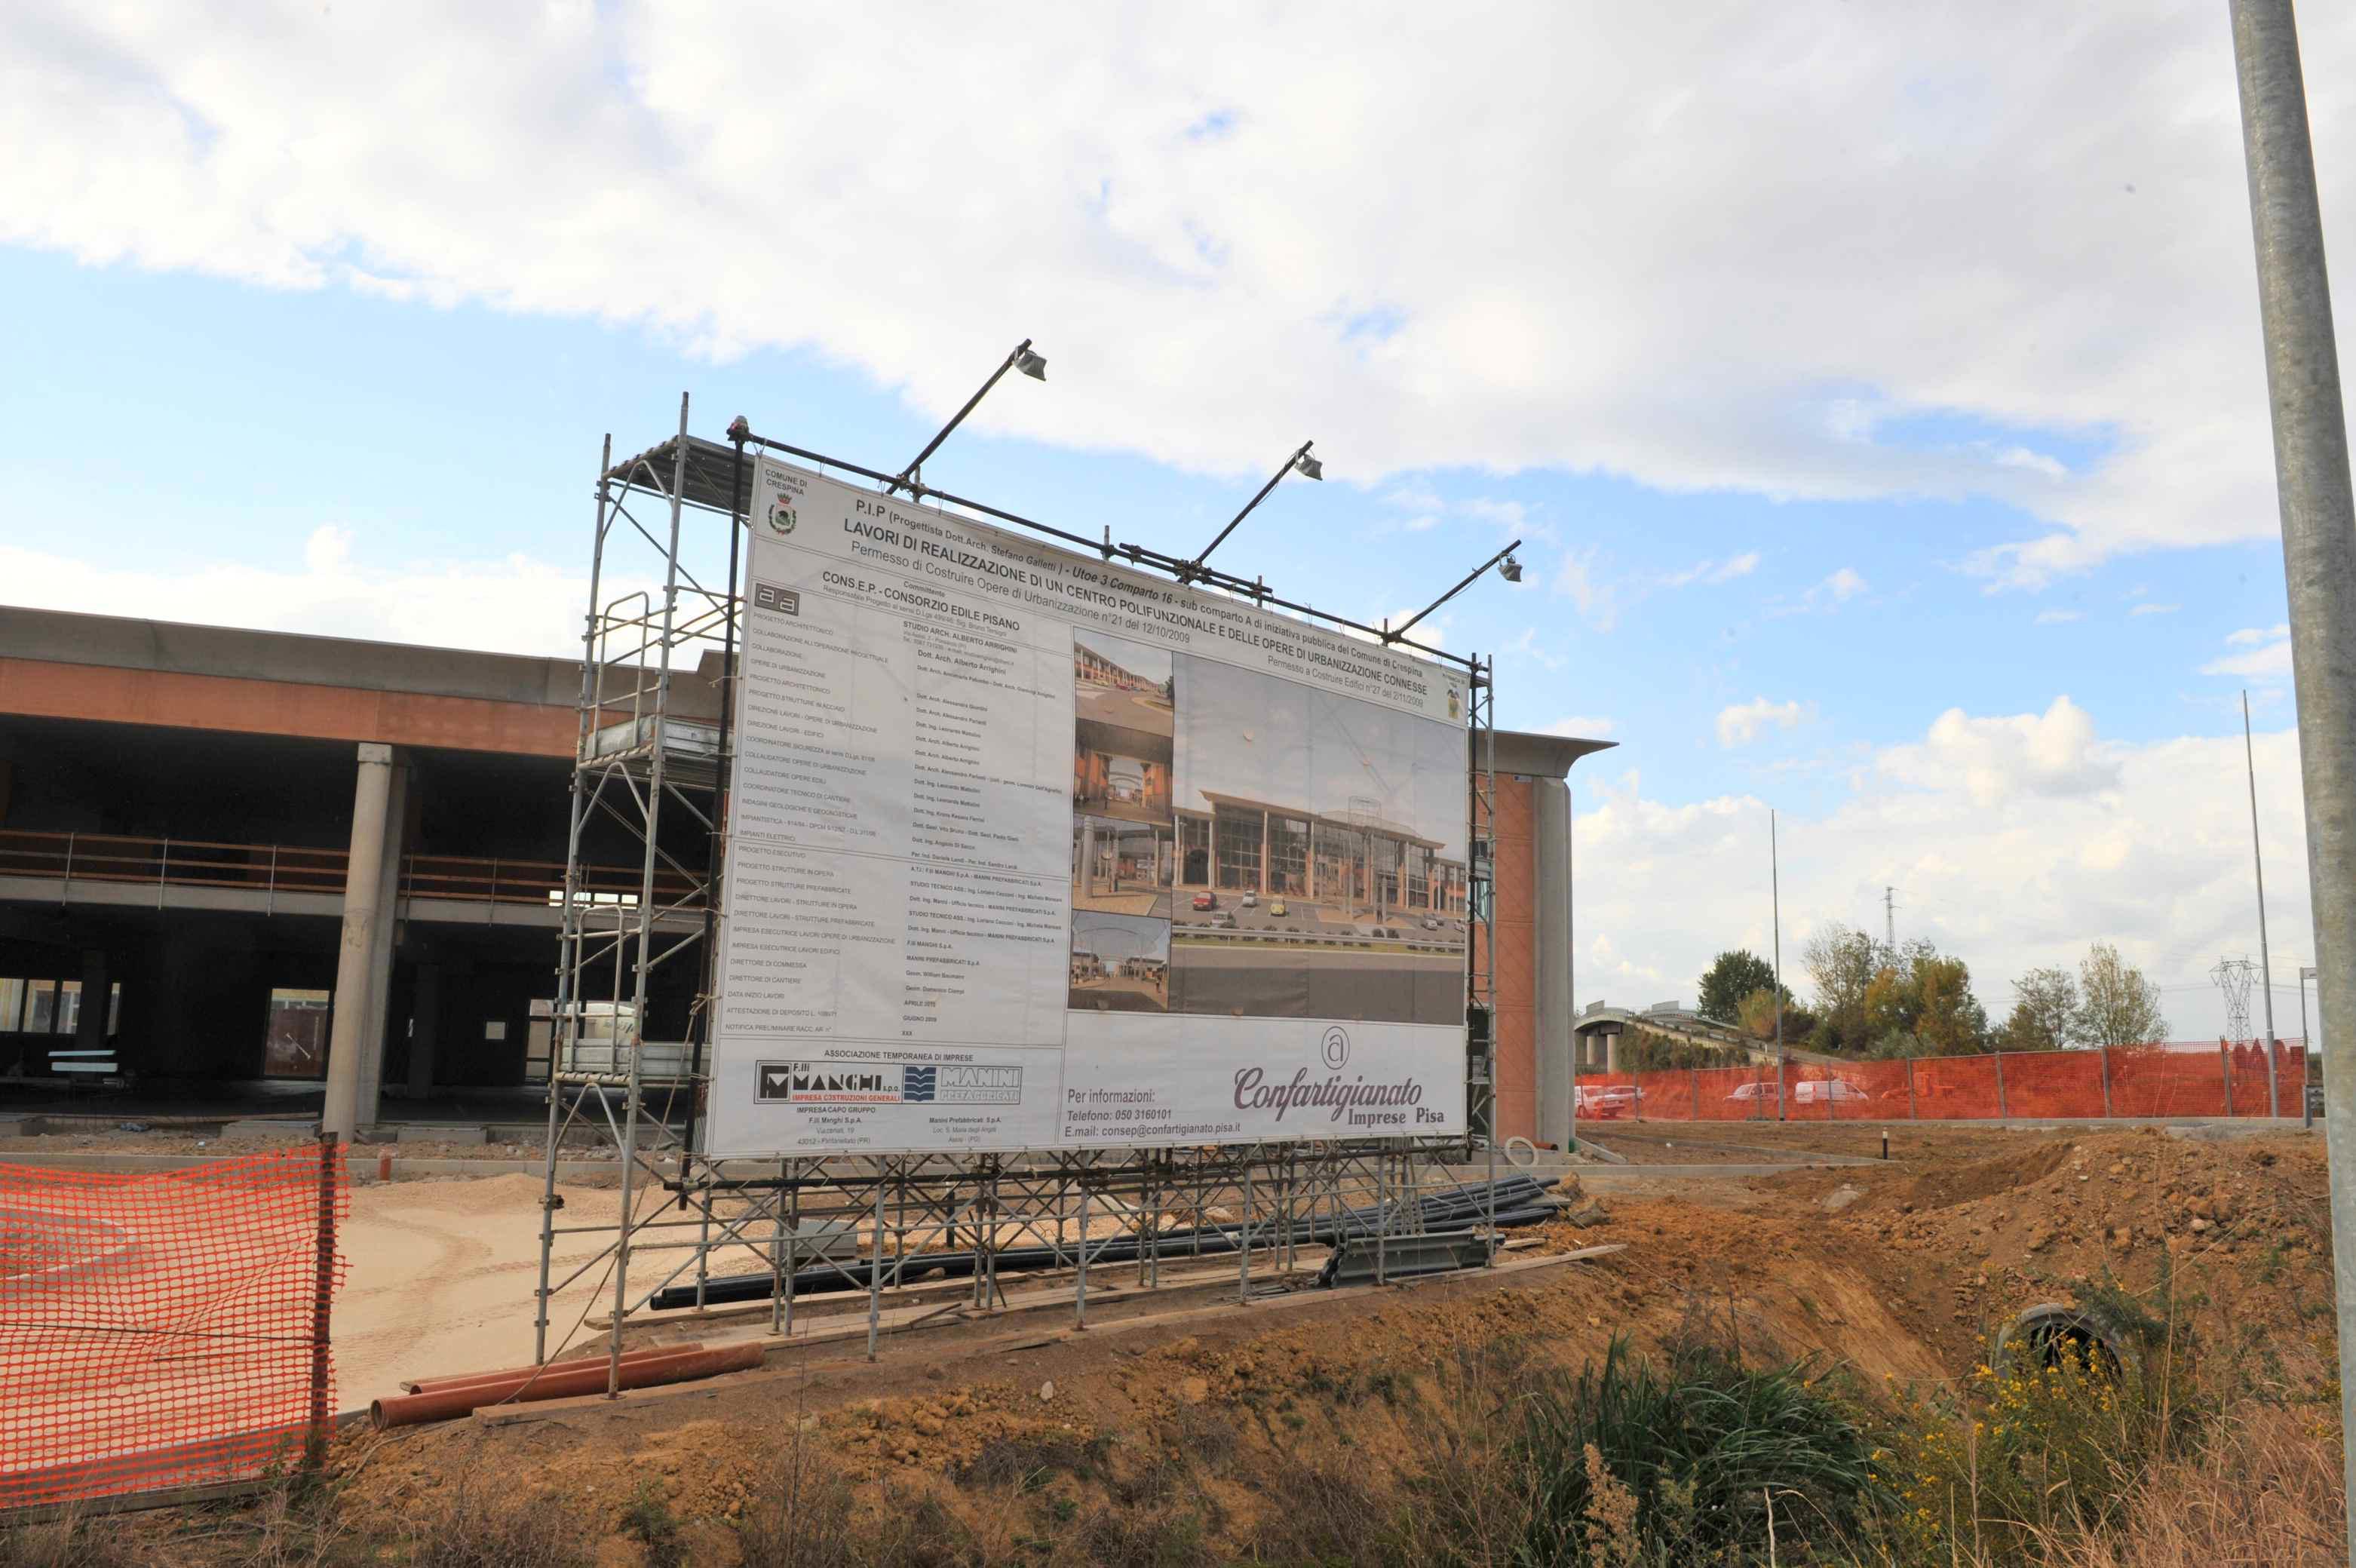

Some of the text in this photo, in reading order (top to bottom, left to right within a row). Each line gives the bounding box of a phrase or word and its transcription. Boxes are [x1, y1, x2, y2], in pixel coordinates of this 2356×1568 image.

[765, 468, 807, 488] COMUNE DI
[766, 478, 804, 496] CRESPINA
[851, 540, 910, 568] Permesso
[912, 558, 923, 571] di
[925, 562, 975, 586] Costruire
[977, 576, 1010, 596] Opere
[1011, 586, 1022, 600] di
[1024, 590, 1100, 621] Urbanizzazione
[1124, 617, 1140, 631] del
[1141, 621, 1189, 644] 12/10/2009
[856, 499, 885, 519] P.I.P
[889, 512, 943, 538] (Progettista
[945, 527, 988, 551] Dott.Arch.
[991, 540, 1023, 562] Stefano
[1026, 550, 1056, 572] Galletti
[1072, 565, 1097, 584] Utoe
[1100, 573, 1107, 587] 3
[1110, 576, 1158, 603] Comparto
[1162, 591, 1172, 605] 16
[1181, 595, 1197, 612] sub
[1200, 603, 1243, 625] comparto
[1245, 615, 1251, 626] A
[1254, 618, 1262, 629] di
[1264, 621, 1300, 640] iniziativa
[1302, 633, 1335, 652] pubblica
[1338, 643, 1348, 655] del
[1351, 647, 1381, 664] Comune
[1383, 657, 1390, 667] di
[1392, 659, 1422, 677] Crespina
[822, 570, 877, 594] CONS.E.P.
[884, 587, 949, 613] CONSORZIO
[950, 604, 981, 621] EDILE
[982, 612, 1020, 631] PISANO
[844, 517, 900, 546] LAVORI
[901, 534, 918, 551] DI
[919, 540, 1026, 583] REALIZZAZIONE
[1028, 573, 1042, 588] DI
[1044, 578, 1063, 594] UN
[1065, 583, 1117, 609] CENTRO
[1118, 597, 1215, 636] POLIFUNZIONALE
[1216, 624, 1225, 637] E
[1226, 627, 1259, 646] DELLE
[1260, 637, 1293, 656] OPERE
[1294, 646, 1305, 659] DI
[1306, 650, 1382, 681] URBANIZZAZIONE
[1382, 673, 1427, 695] CONNESSE
[918, 649, 1005, 676] Dott. Arch. Alberto Arrighini
[824, 1050, 882, 1058] ASSOCIAZIONE
[940, 1066, 1019, 1087] MANINI
[1066, 1088, 1155, 1103] Per informazioni:
[1232, 1066, 1422, 1123] Confartigianato
[1066, 1109, 1172, 1121] Telefono: 050 3160101
[1348, 1107, 1444, 1125] Imprese Pisa
[1064, 1122, 1241, 1137] E.mail: consep@confartigianato.pisa.it
